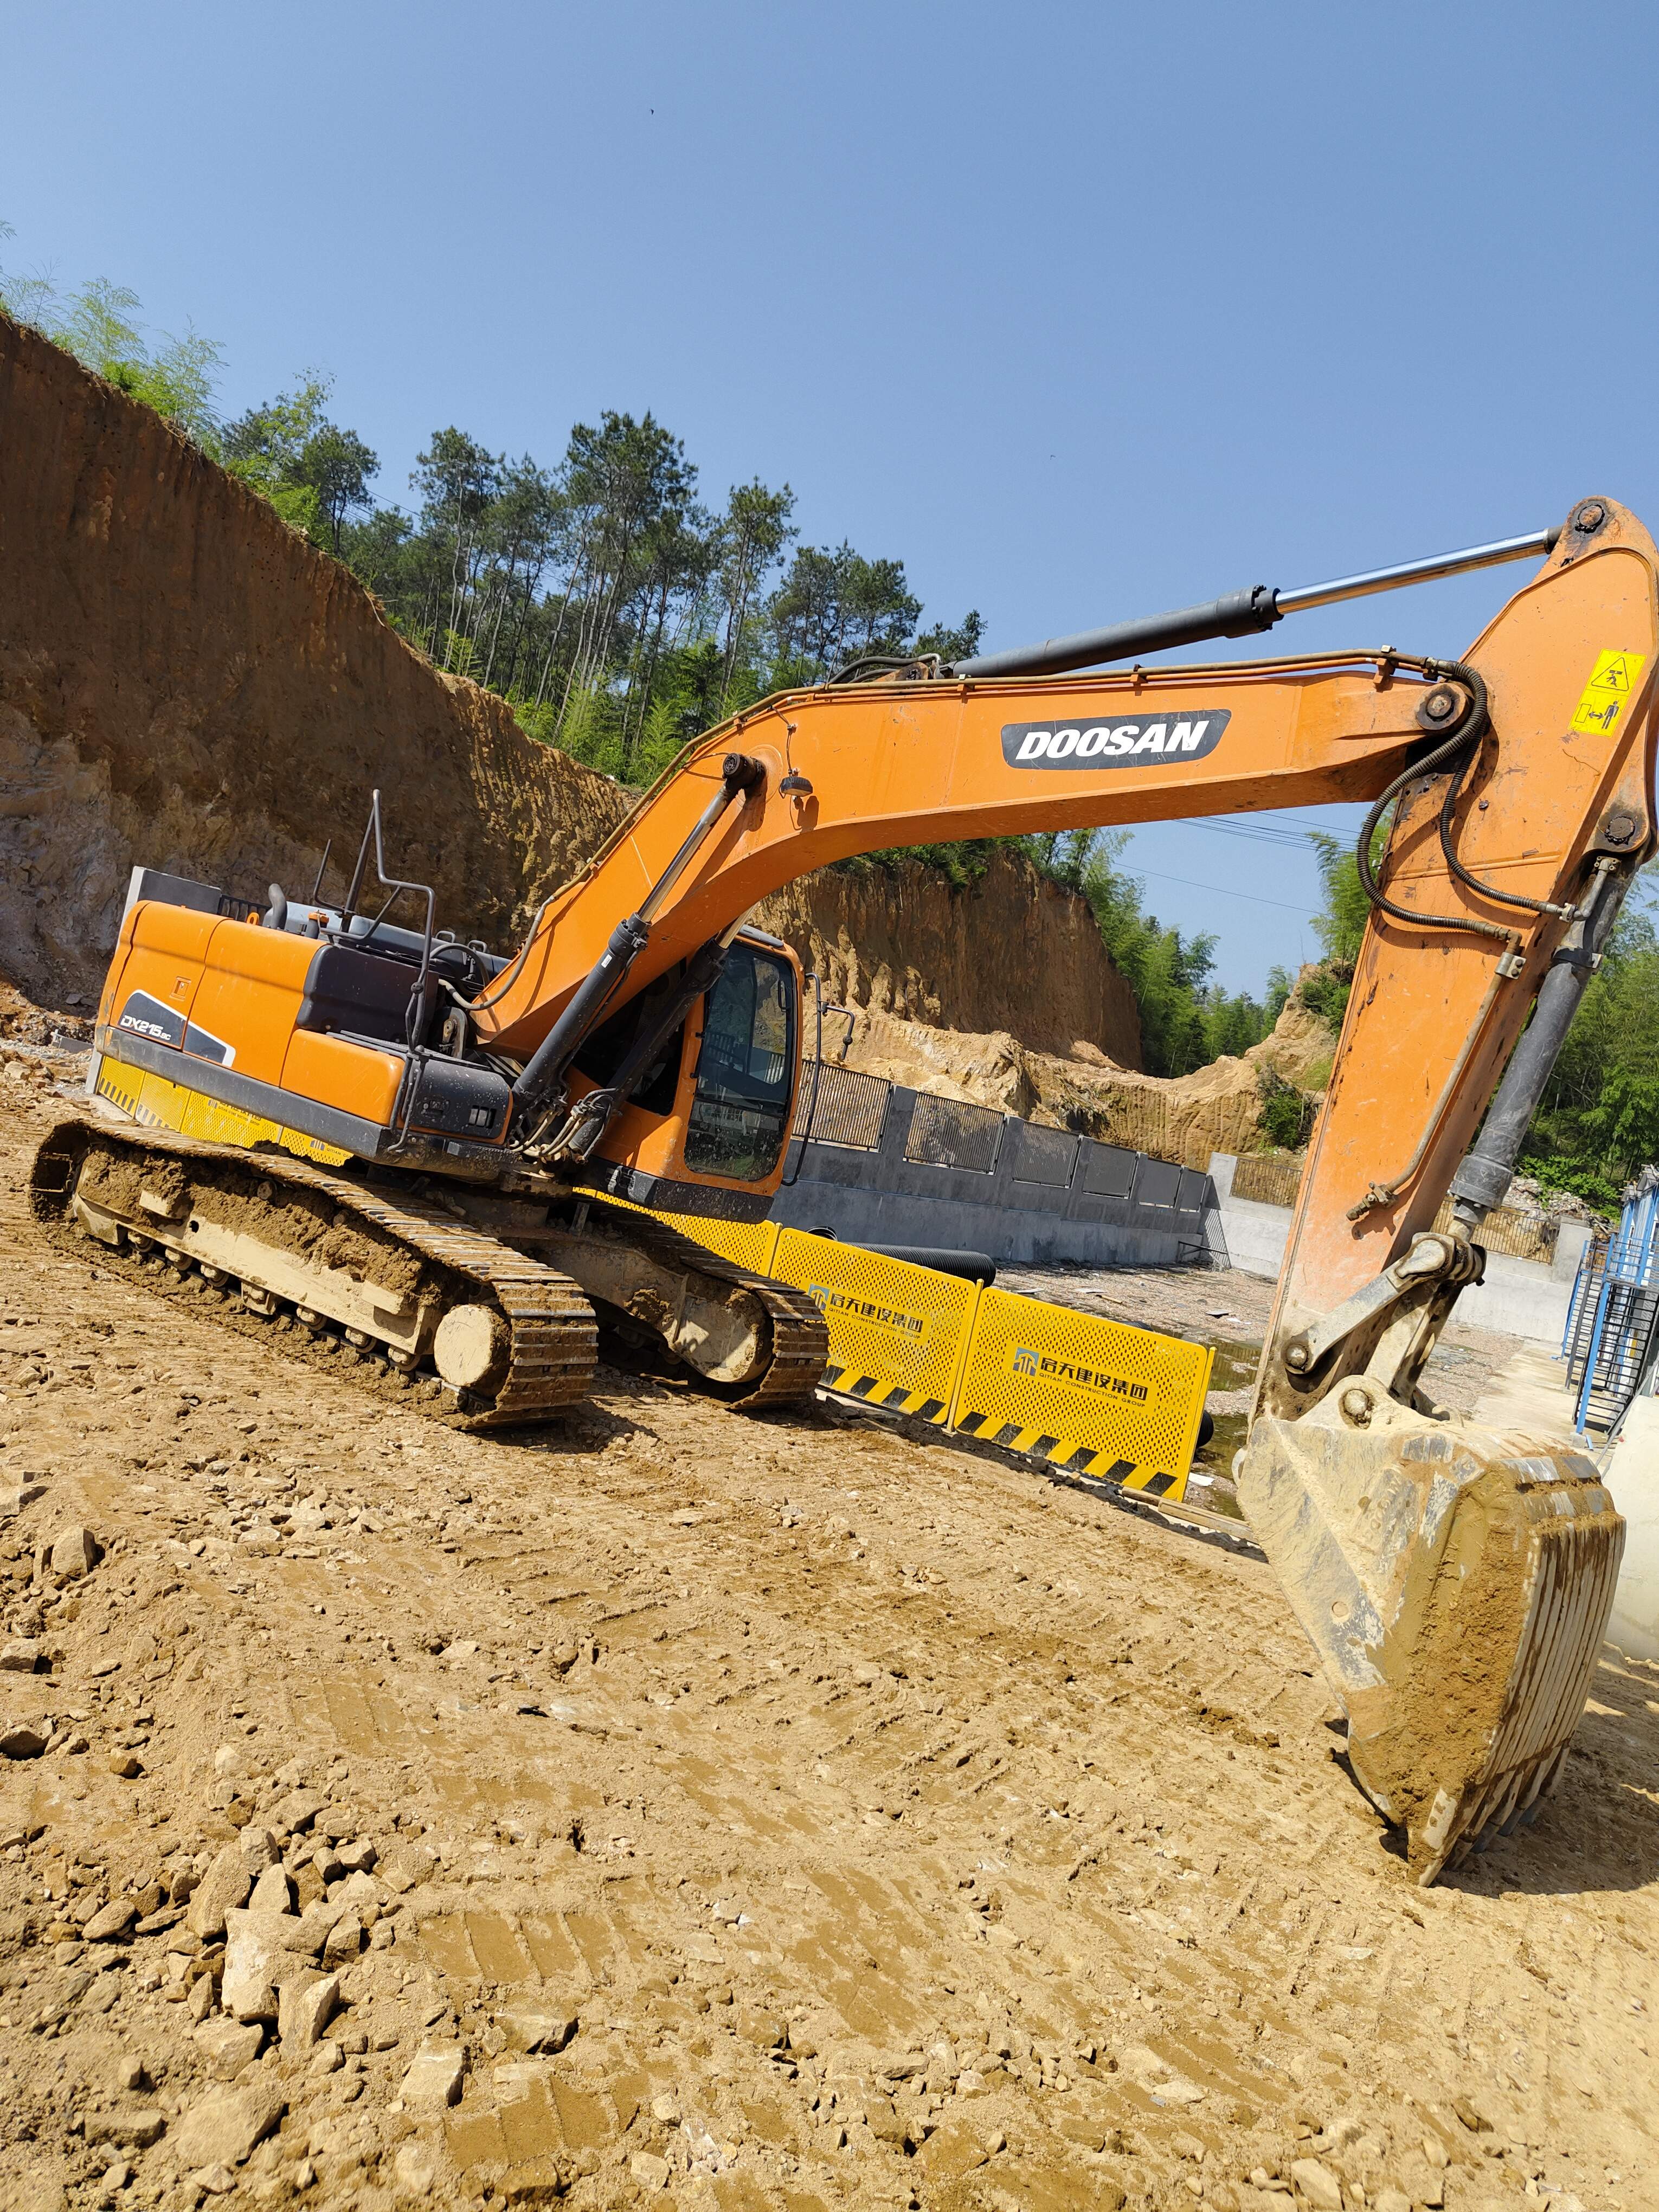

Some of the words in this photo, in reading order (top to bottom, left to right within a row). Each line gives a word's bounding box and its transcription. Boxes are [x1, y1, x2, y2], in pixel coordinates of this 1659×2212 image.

[1015, 721, 1210, 760] DOOSAN
[829, 1308, 849, 1316] QITIAN
[851, 1315, 897, 1332] CONSTRUCTION
[900, 1330, 921, 1339] GROUP
[831, 1293, 923, 1333] 启天建设集团
[1039, 1373, 1062, 1382] QITIAN
[1065, 1381, 1118, 1399] CONSTRUCTION
[1121, 1398, 1145, 1408] GROUP
[1041, 1357, 1148, 1400] 启天建设集团
